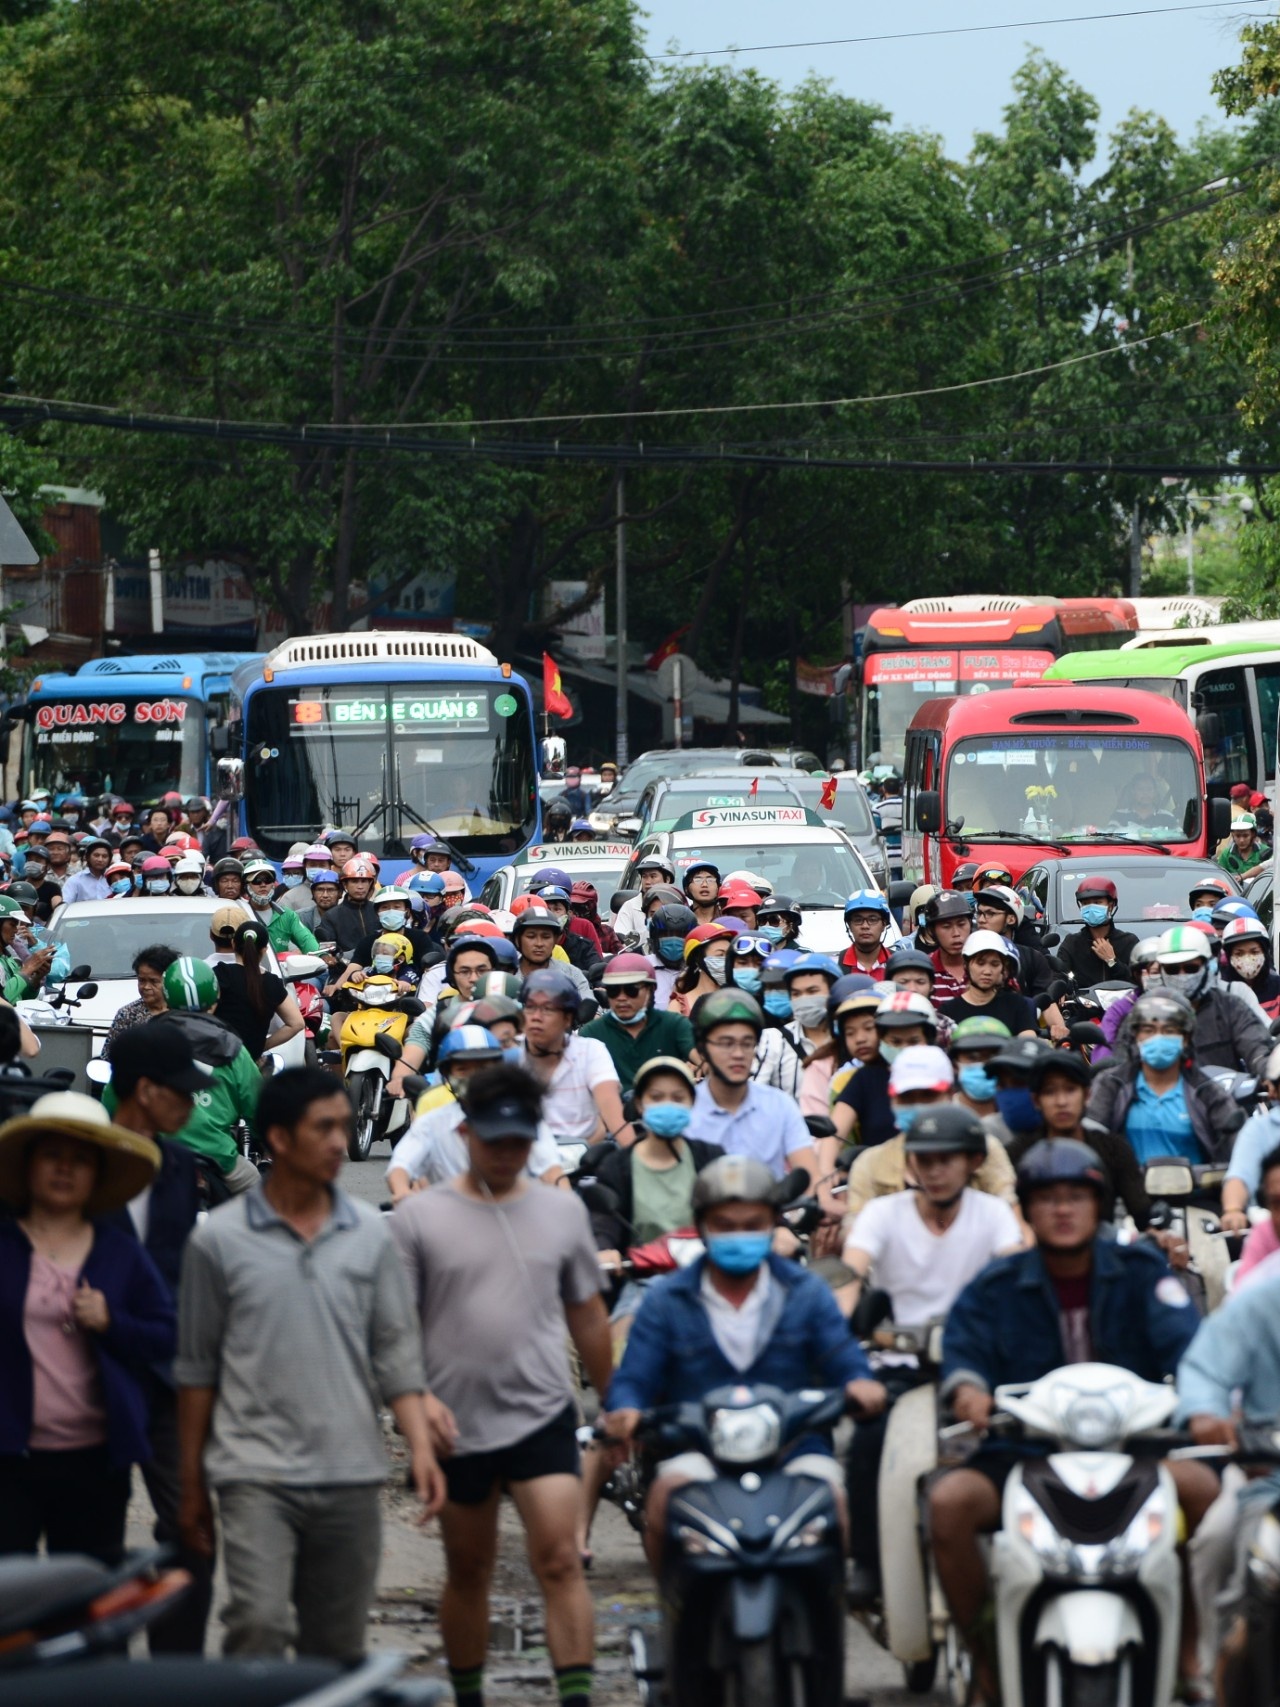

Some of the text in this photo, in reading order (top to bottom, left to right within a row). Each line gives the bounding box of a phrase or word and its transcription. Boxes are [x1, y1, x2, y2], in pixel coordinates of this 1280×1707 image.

[965, 656, 998, 668] FUTA
[37, 699, 188, 729] QUANG SƠN
[466, 703, 478, 717] 8
